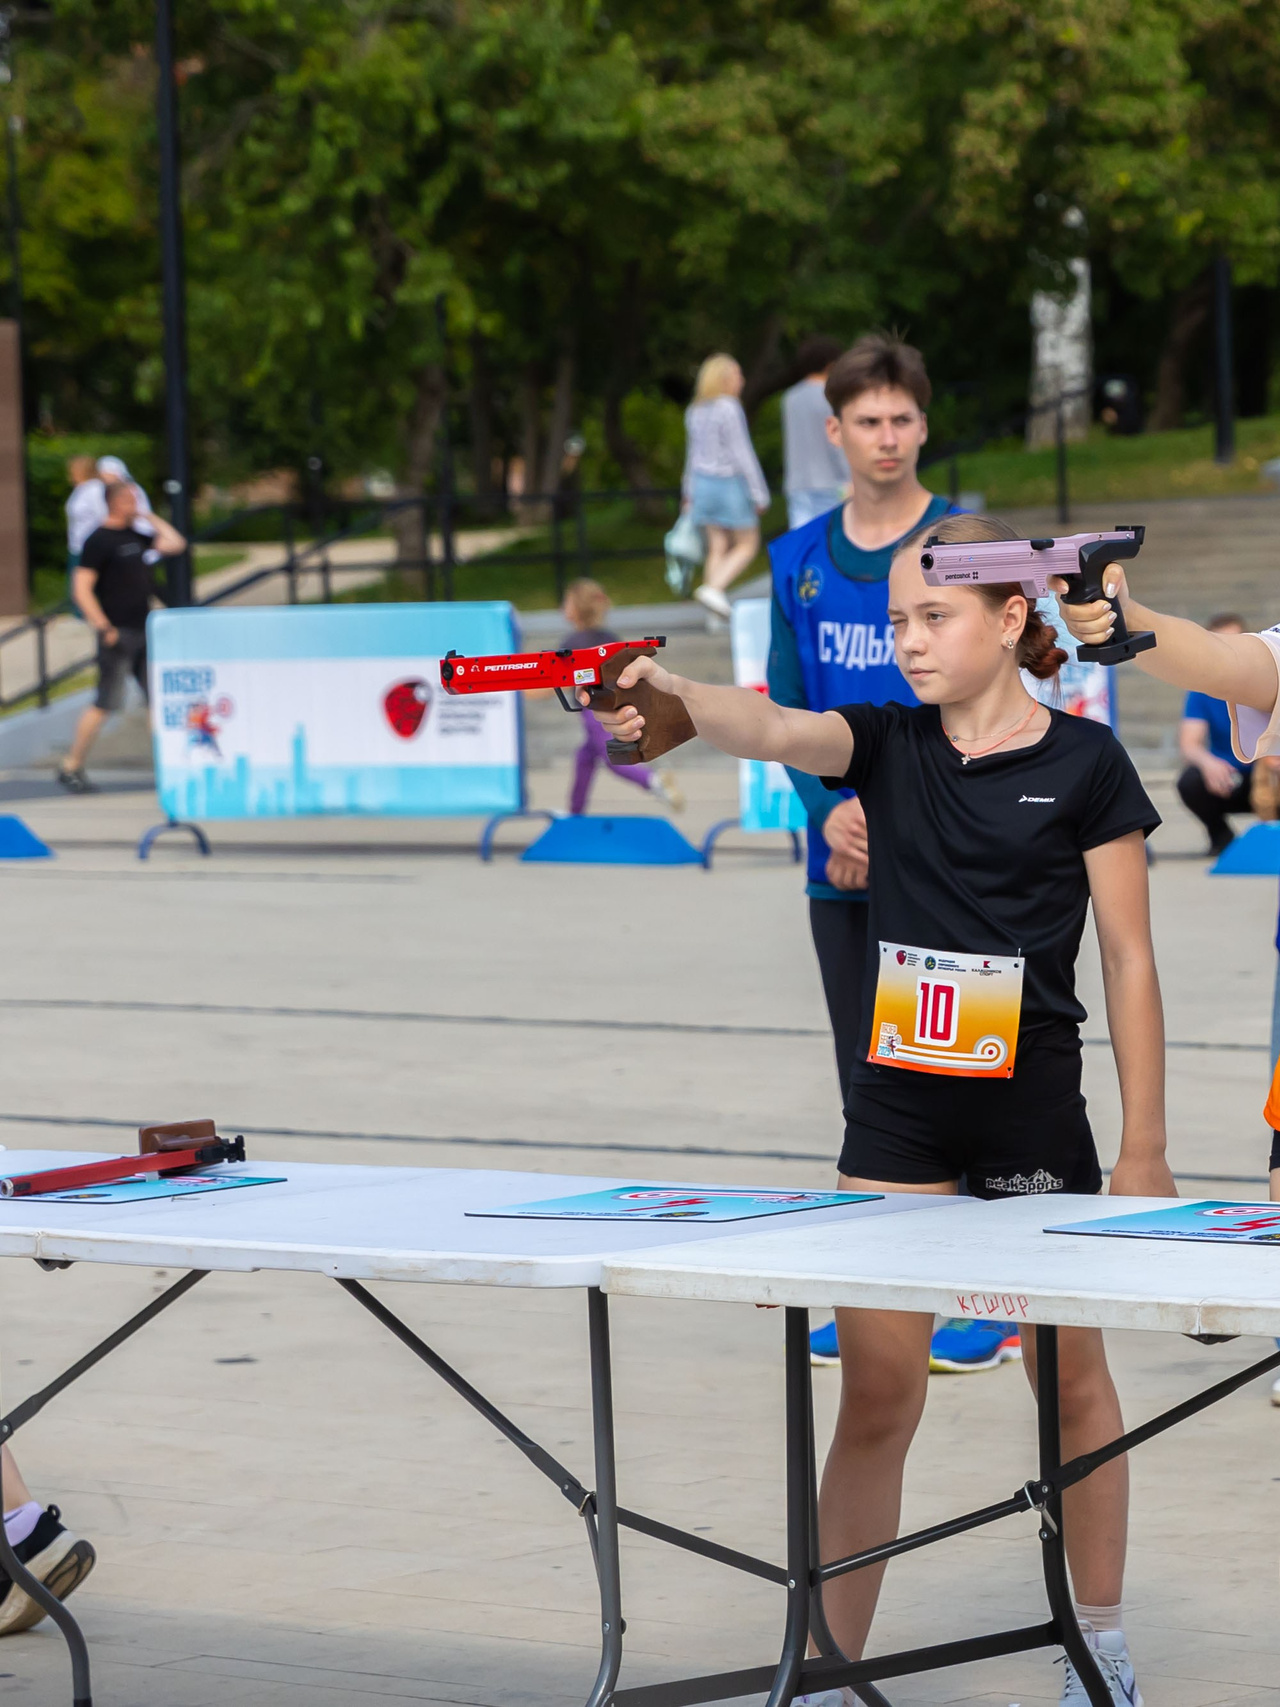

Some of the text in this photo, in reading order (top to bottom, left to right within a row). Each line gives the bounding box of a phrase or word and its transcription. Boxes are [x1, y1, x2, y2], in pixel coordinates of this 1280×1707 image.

[945, 572, 971, 581] pentashot
[818, 620, 898, 671] СУДЬЯ
[484, 661, 538, 672] PENTASHOT
[918, 981, 955, 1042] 10
